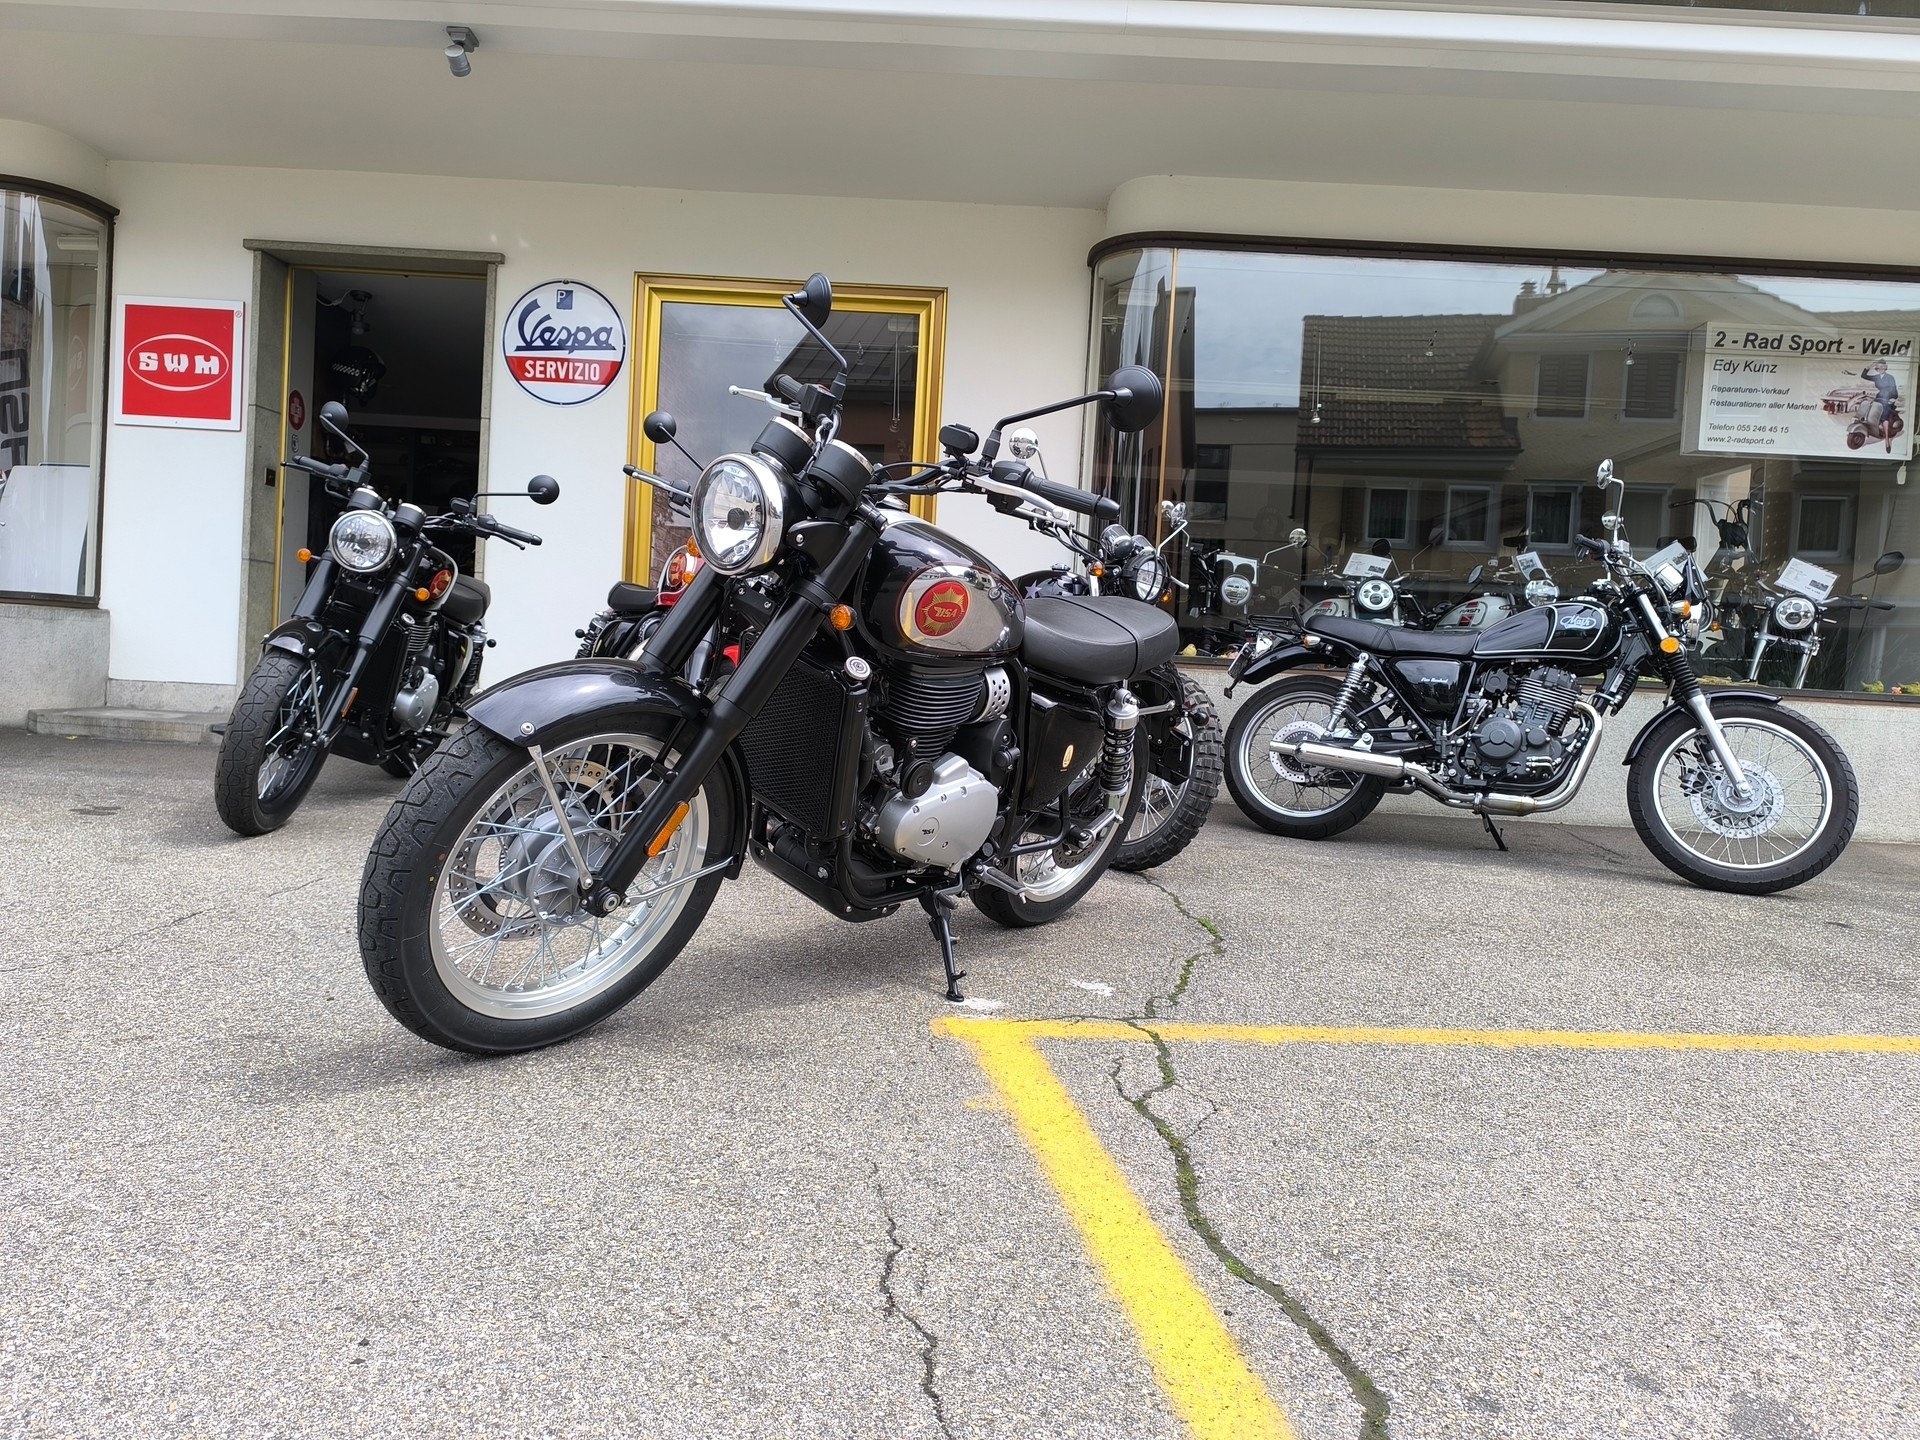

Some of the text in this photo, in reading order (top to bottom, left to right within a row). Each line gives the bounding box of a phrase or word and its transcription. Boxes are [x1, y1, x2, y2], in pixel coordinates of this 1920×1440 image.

[514, 298, 617, 355] Vespa
[1714, 330, 1727, 348] 2
[1742, 332, 1784, 350] Rad
[1788, 334, 1844, 356] Sport
[1862, 338, 1912, 355] Wald
[138, 351, 221, 376] SWM
[524, 360, 600, 382] SERVIZIO
[1713, 359, 1778, 375] Edy Kunz
[1710, 384, 1791, 396] Reparaturen-Verkauf
[1709, 398, 1767, 409] Restaurationen
[1786, 402, 1818, 411] Marken!
[1709, 422, 1790, 434] Telefon 055 246 45 15
[1707, 435, 1775, 446] www.2-radsport.ch
